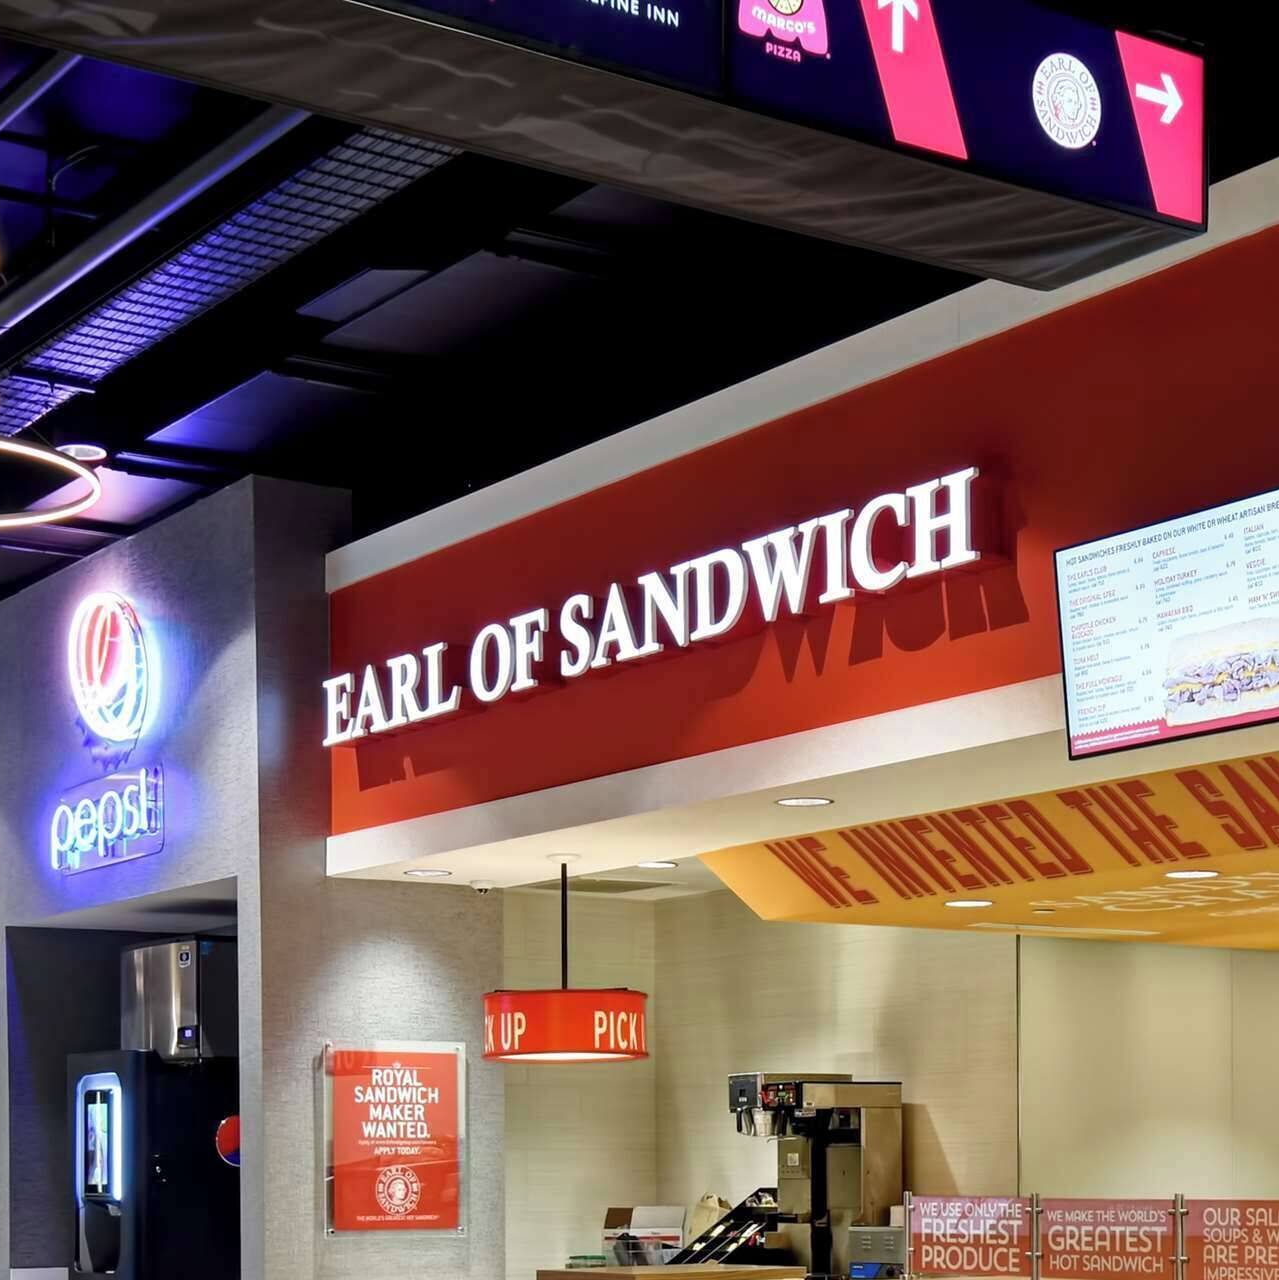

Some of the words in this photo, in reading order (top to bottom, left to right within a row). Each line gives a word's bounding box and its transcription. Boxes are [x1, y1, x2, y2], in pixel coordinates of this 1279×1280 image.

[647, 3, 679, 28] INN
[766, 41, 801, 62] PIZZA
[1040, 57, 1076, 80] EARL
[1079, 71, 1096, 93] OF
[1036, 99, 1097, 144] SANDWICH
[322, 641, 463, 747] EARL
[469, 607, 548, 703] OF
[560, 466, 981, 677] SANDWICH
[763, 836, 880, 909] WE
[838, 800, 1095, 900] INVENTED
[1056, 779, 1210, 868] THE
[500, 1011, 527, 1051] UP
[594, 1010, 638, 1050] PICK
[372, 1068, 423, 1086] ROYAL
[354, 1086, 439, 1104] SANDWICH
[370, 1103, 425, 1121] MAKER
[362, 1121, 431, 1139] WANTED.
[374, 1146, 396, 1155] APPLY
[919, 1202, 938, 1216] WE
[940, 1202, 962, 1217] USE
[967, 1202, 998, 1217] ONLY
[999, 1203, 1022, 1219] THE
[1047, 1210, 1063, 1222] WE
[1065, 1210, 1095, 1222] MAKE
[1096, 1210, 1116, 1222] THE
[1118, 1209, 1166, 1222] WORLD'S
[1203, 1207, 1241, 1227] OUR
[921, 1218, 1022, 1245] FRESHEST
[1048, 1225, 1167, 1252] GREATEST
[1203, 1228, 1248, 1243] SOUPS
[1252, 1228, 1262, 1242] &
[921, 1246, 1020, 1272] PRODUCE
[1049, 1254, 1079, 1271] HOT
[1082, 1254, 1164, 1273] SANDWICH
[1203, 1245, 1238, 1264] ARE
